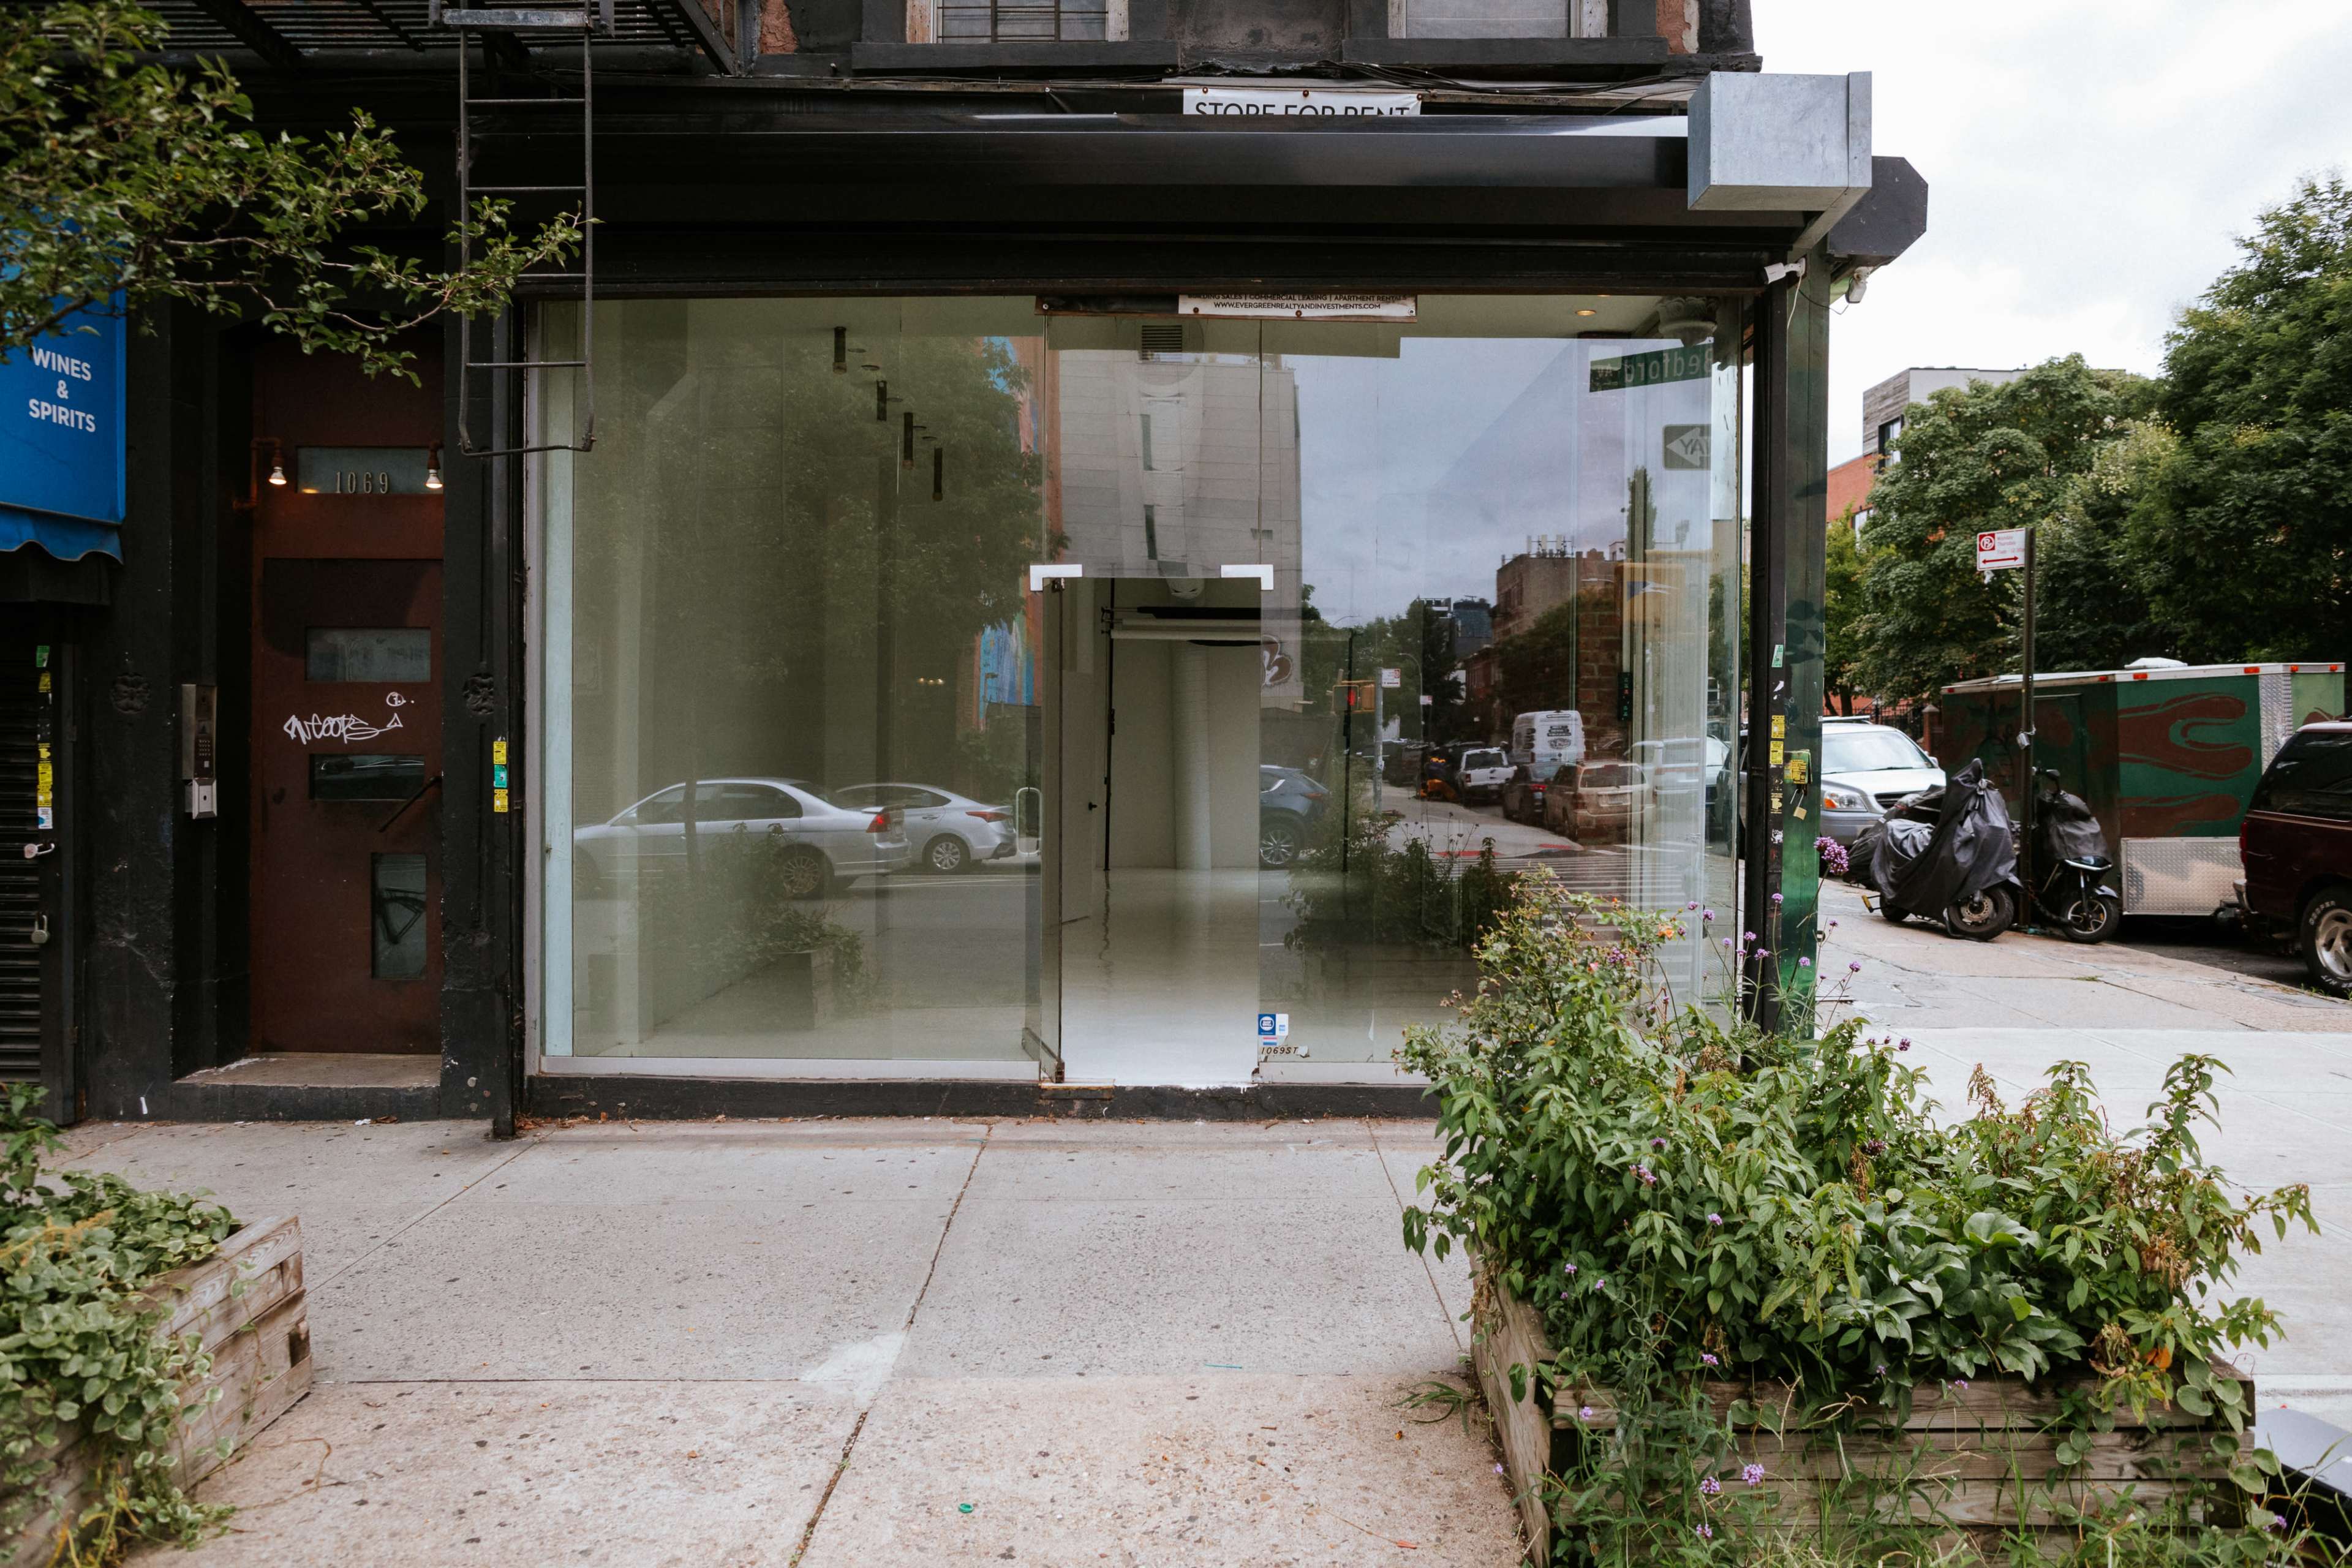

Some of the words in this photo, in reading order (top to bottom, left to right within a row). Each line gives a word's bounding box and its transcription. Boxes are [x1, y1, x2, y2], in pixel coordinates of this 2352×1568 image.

[32, 345, 92, 382] WINES
[56, 379, 69, 399] &
[28, 398, 96, 432] SPIRITS
[336, 471, 390, 494] 1069
